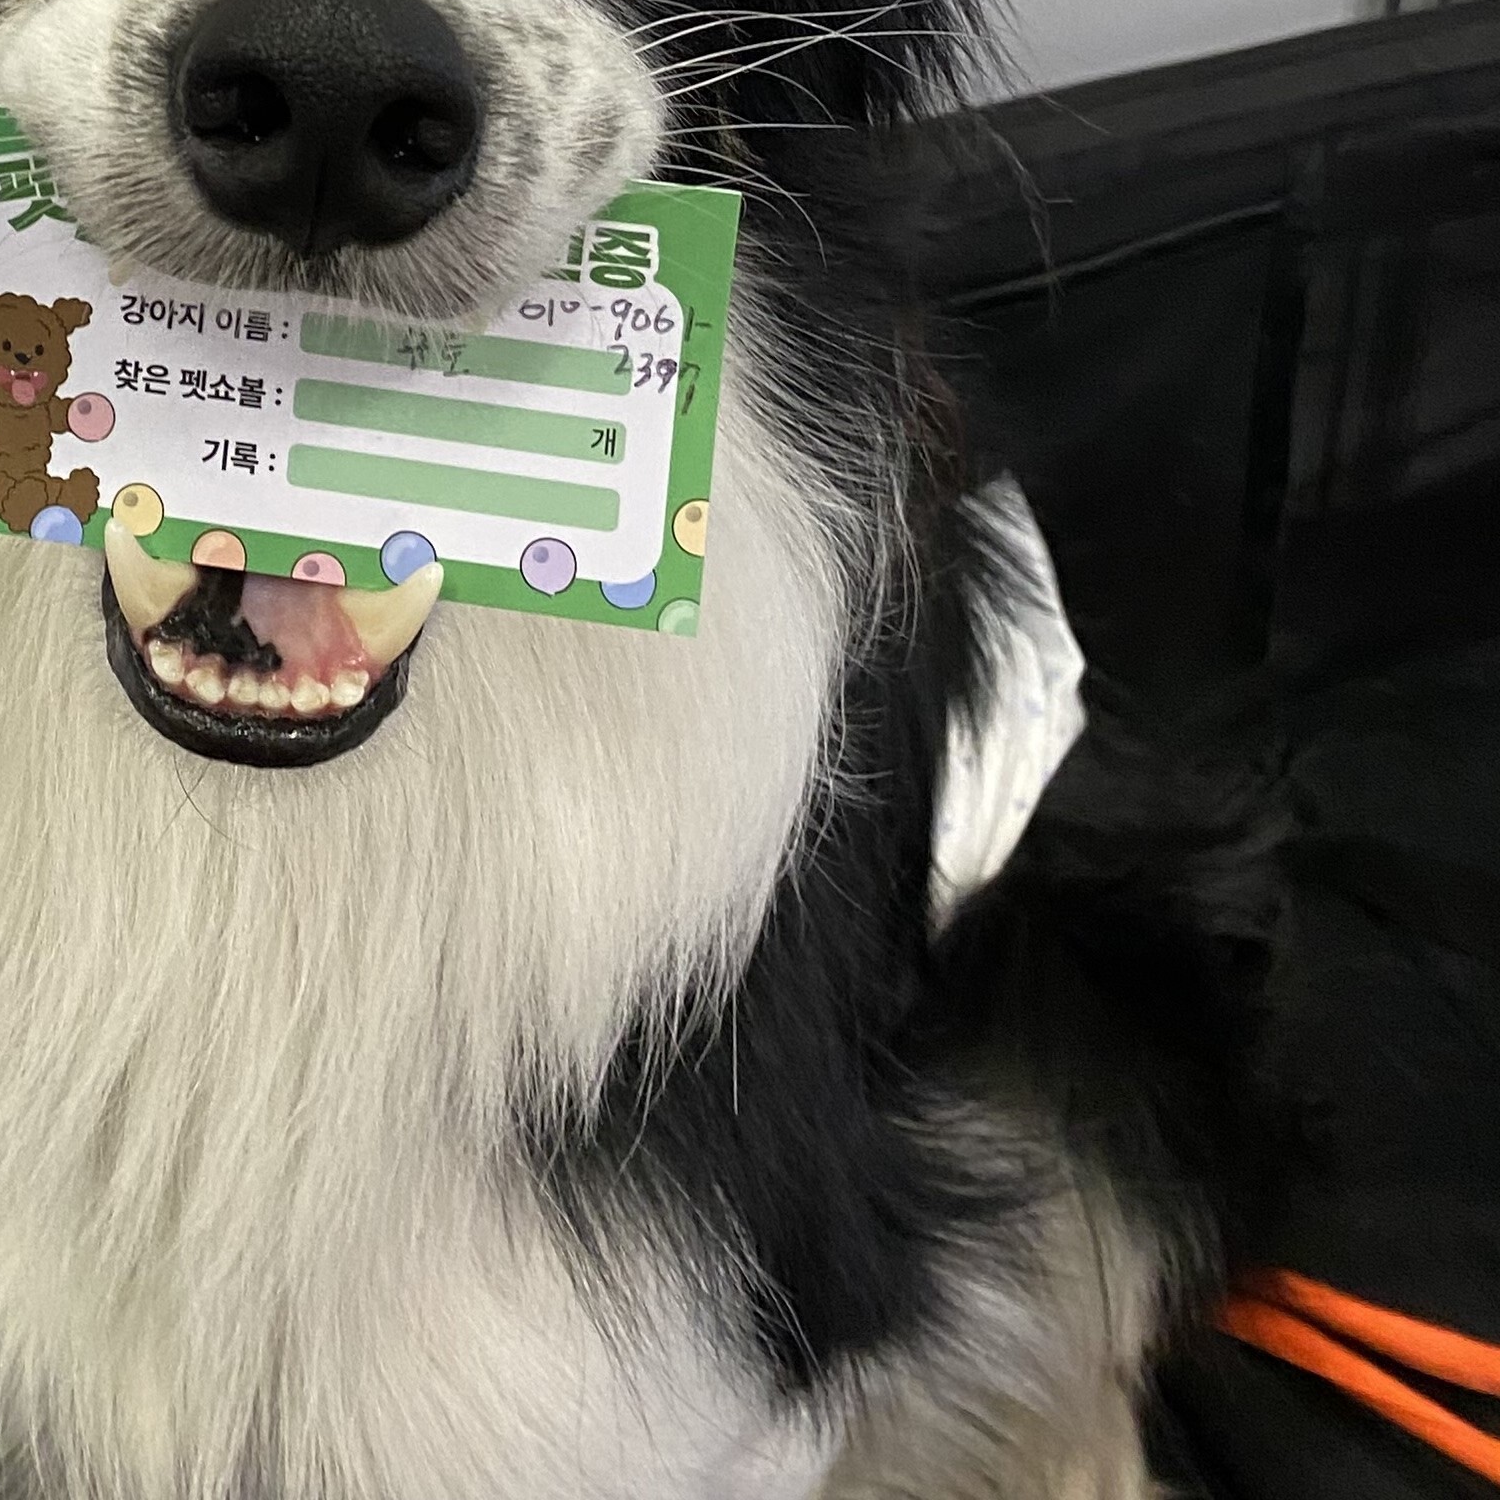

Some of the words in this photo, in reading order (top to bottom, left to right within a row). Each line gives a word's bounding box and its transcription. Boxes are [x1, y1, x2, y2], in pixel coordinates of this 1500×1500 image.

[120, 294, 205, 334] 강아지
[114, 359, 171, 396] 찾은
[590, 427, 617, 458] 개
[201, 439, 259, 475] 기록
